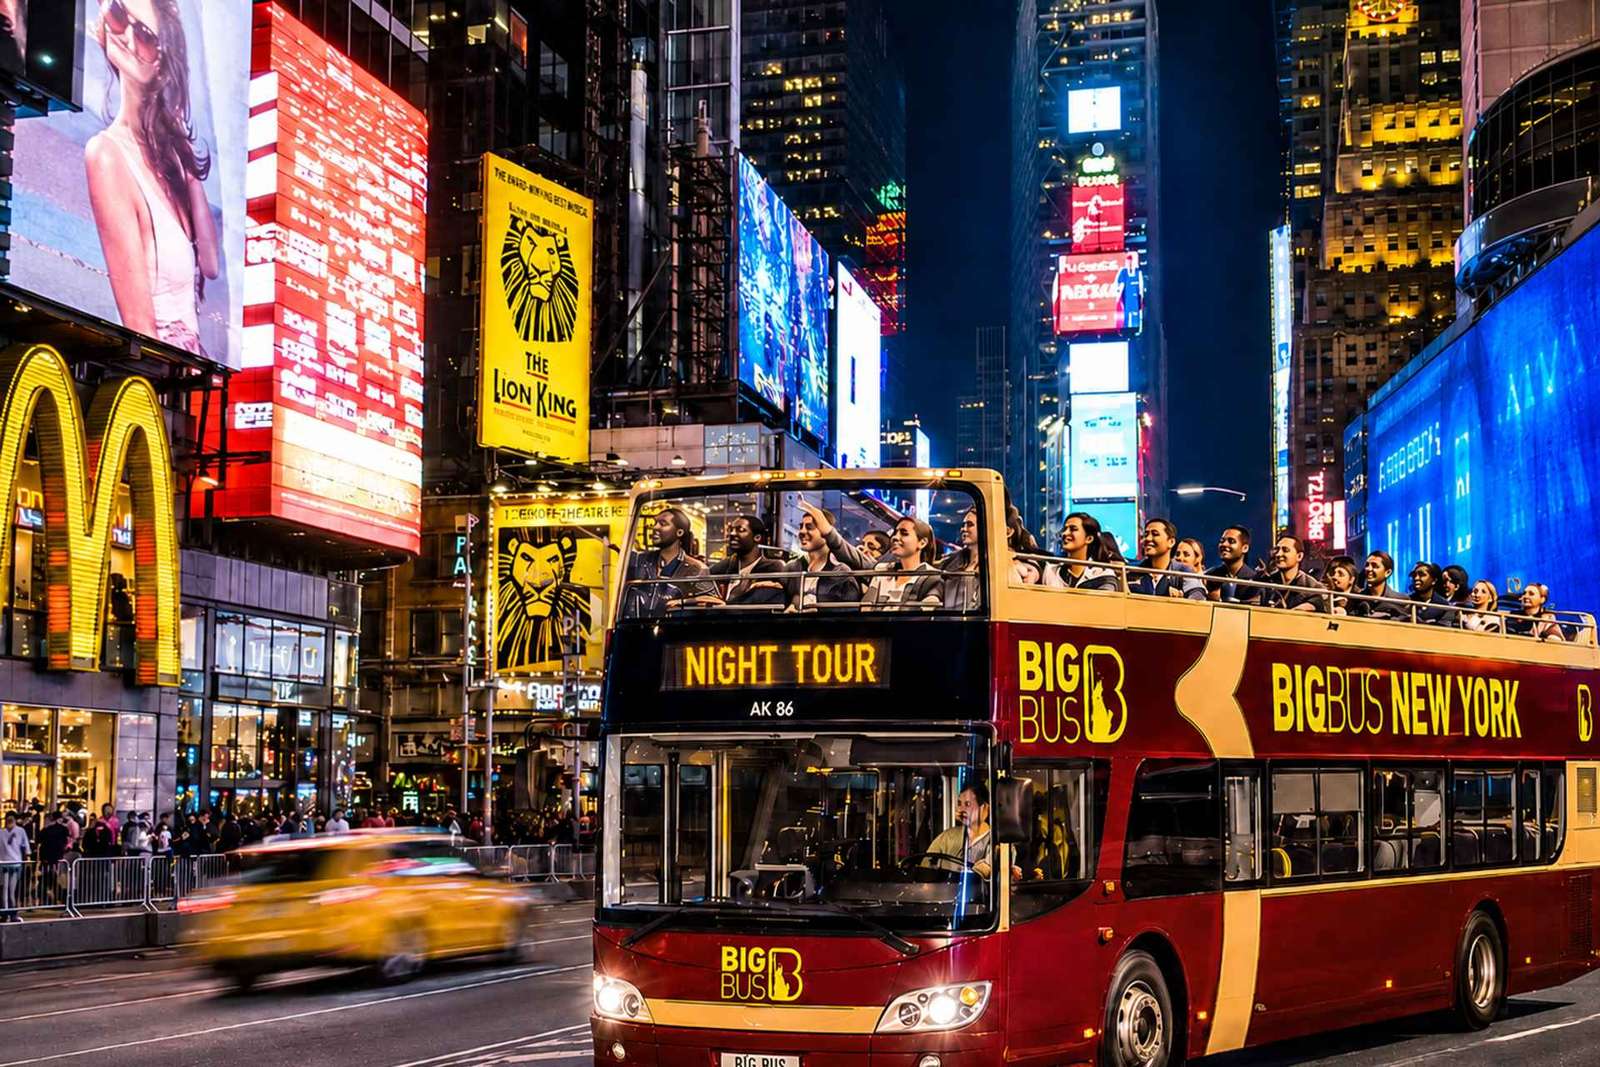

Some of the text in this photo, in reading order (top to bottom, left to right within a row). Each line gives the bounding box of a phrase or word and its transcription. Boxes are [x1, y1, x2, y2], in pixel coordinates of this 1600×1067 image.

[525, 351, 549, 375] THE
[494, 367, 577, 419] LION KING
[686, 643, 876, 686] NIGHT TOUR
[1018, 640, 1080, 693] BIG
[750, 701, 794, 716] AK 86
[1019, 695, 1081, 744] BUS
[1390, 670, 1452, 736] NEW
[1457, 675, 1522, 738] YORK
[721, 946, 766, 973] BIG
[721, 973, 766, 1000] BUS
[735, 1056, 756, 1067] BIG
